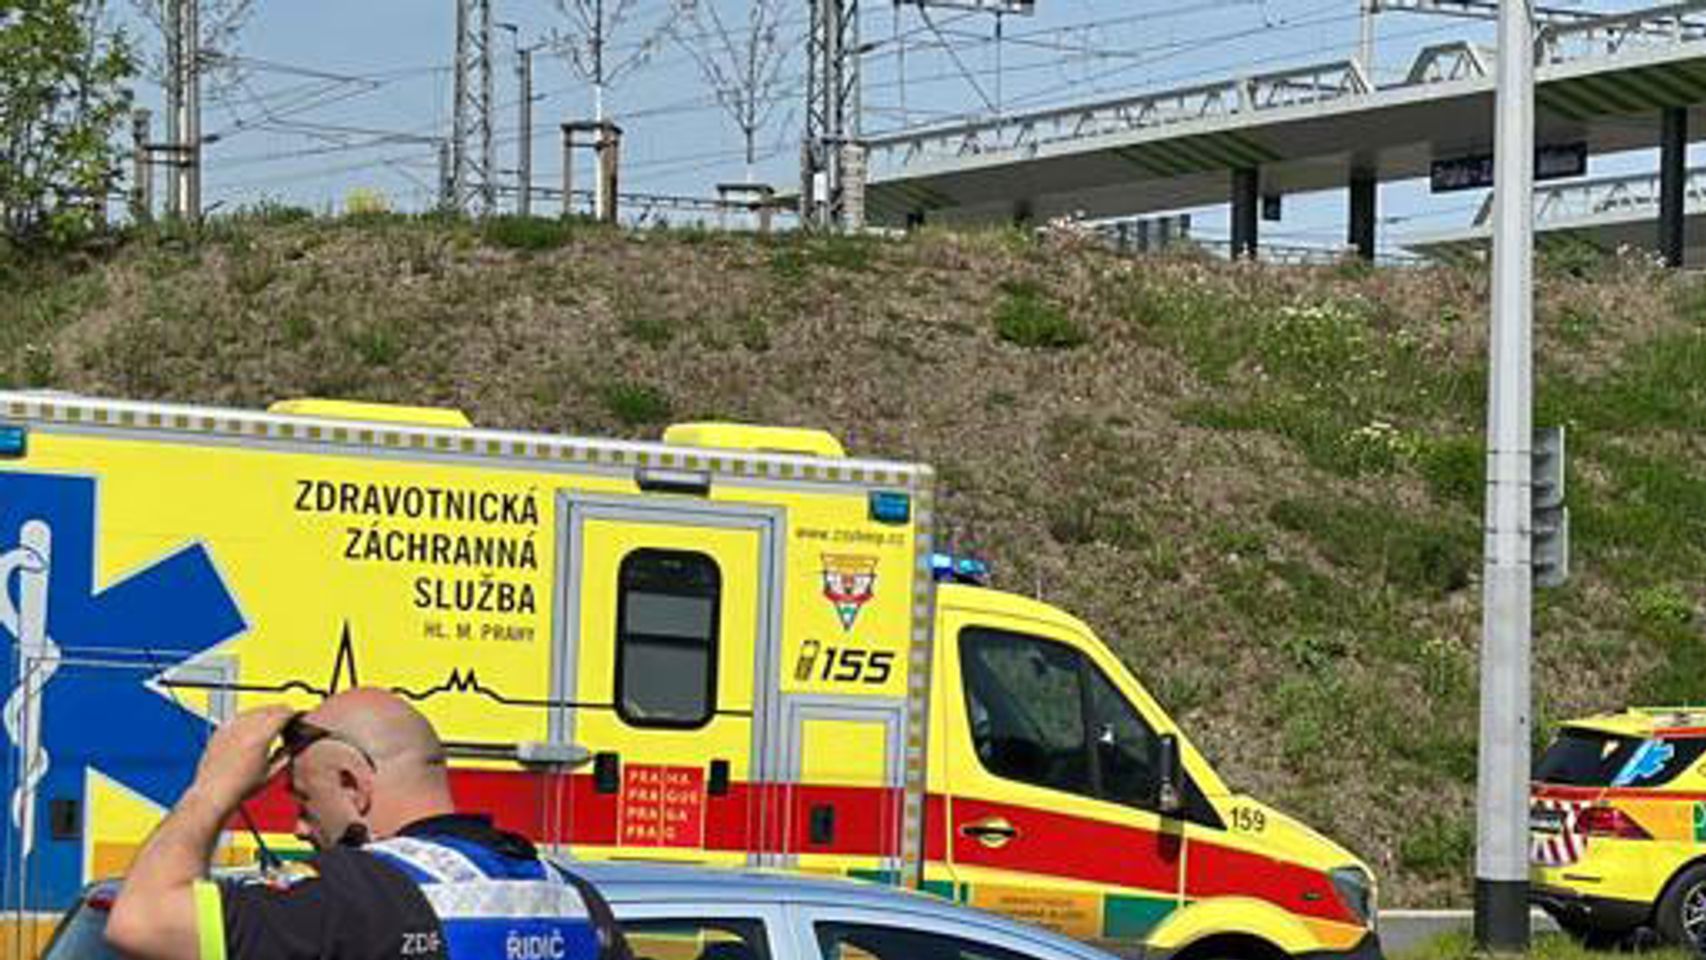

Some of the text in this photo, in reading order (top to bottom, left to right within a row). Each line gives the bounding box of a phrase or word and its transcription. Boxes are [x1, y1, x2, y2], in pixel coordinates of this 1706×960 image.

[295, 479, 539, 526] ZDRAVOTNICKÁ
[344, 519, 538, 570] ZÁCHRANNÁ
[413, 572, 537, 614] SLUŽBA
[822, 647, 896, 684] 155
[1229, 806, 1265, 833] 159
